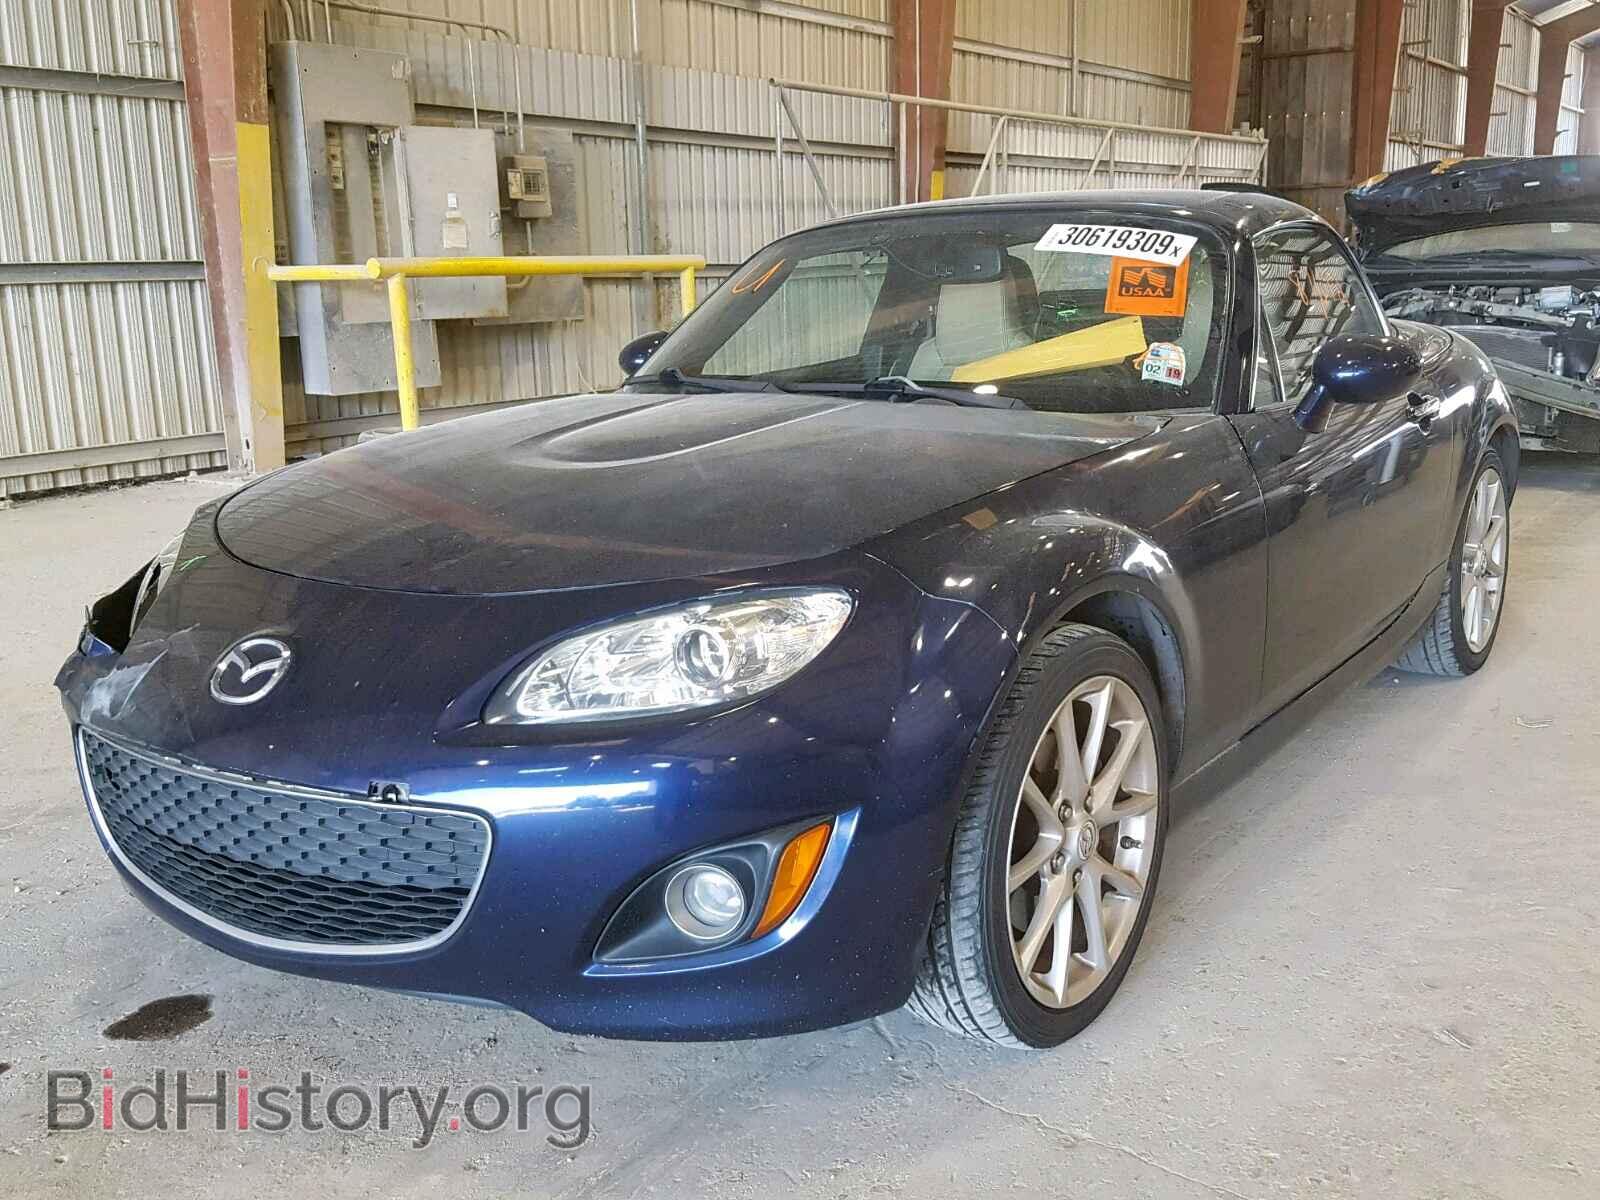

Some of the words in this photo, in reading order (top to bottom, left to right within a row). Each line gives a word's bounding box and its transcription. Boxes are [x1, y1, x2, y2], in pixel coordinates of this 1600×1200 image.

[1121, 287, 1165, 297] USAA
[1146, 363, 1161, 374] 02
[1168, 368, 1181, 379] 19
